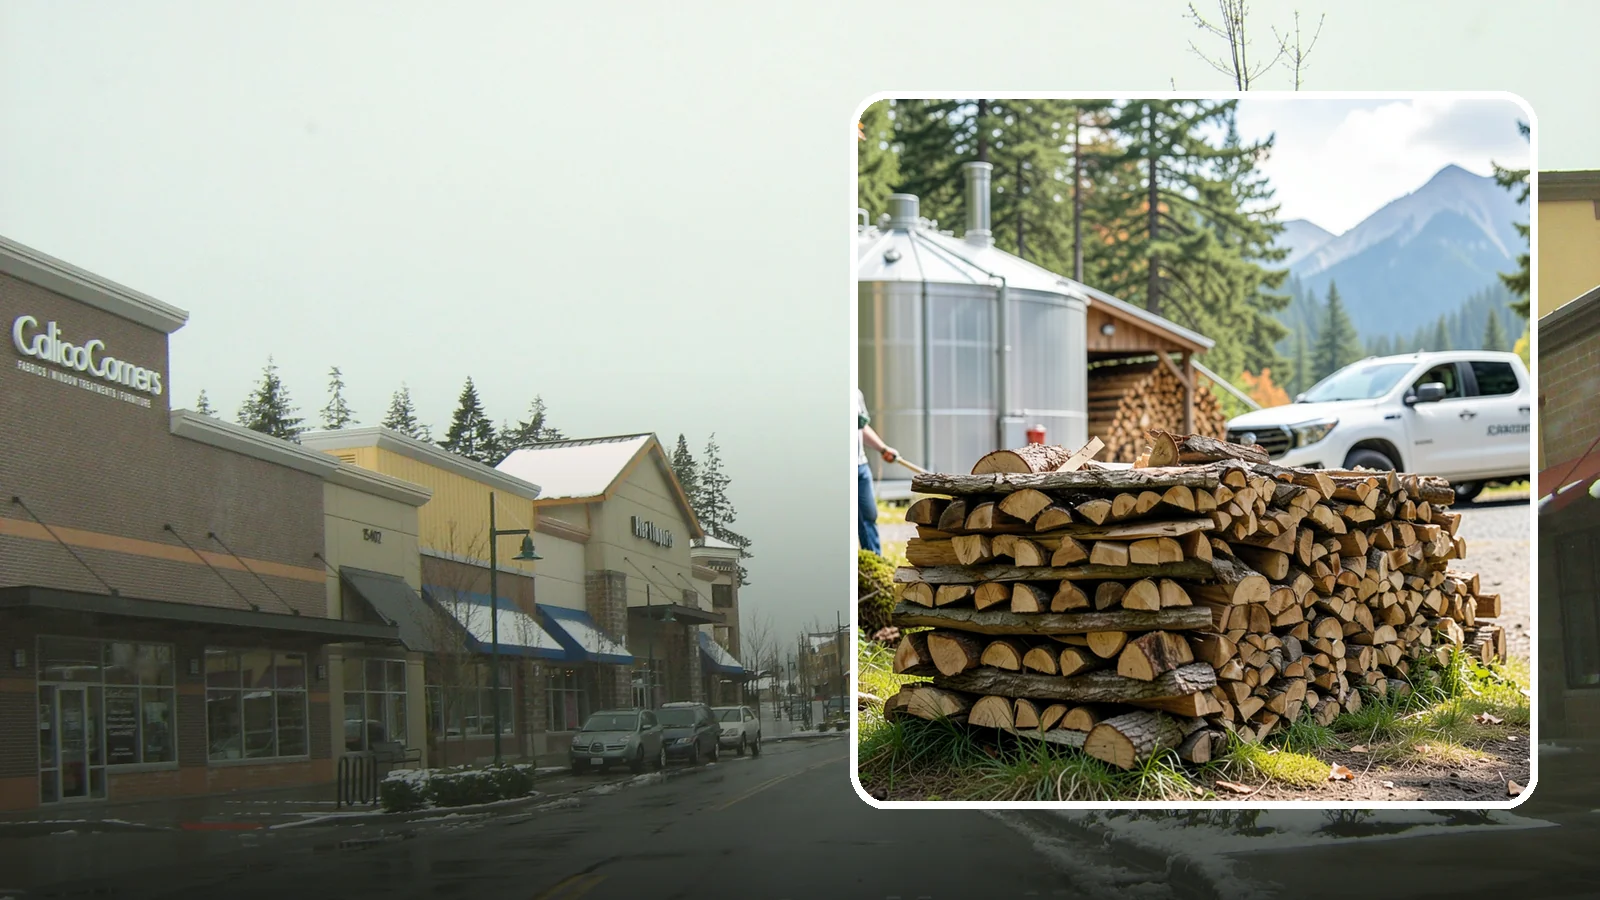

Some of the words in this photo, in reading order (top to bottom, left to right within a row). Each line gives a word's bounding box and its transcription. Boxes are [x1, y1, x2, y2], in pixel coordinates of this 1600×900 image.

[17, 359, 47, 377] FABRICS
[51, 370, 78, 387] WINDOW
[78, 378, 117, 398] TREATMENTS
[120, 391, 151, 409] FURNITURE
